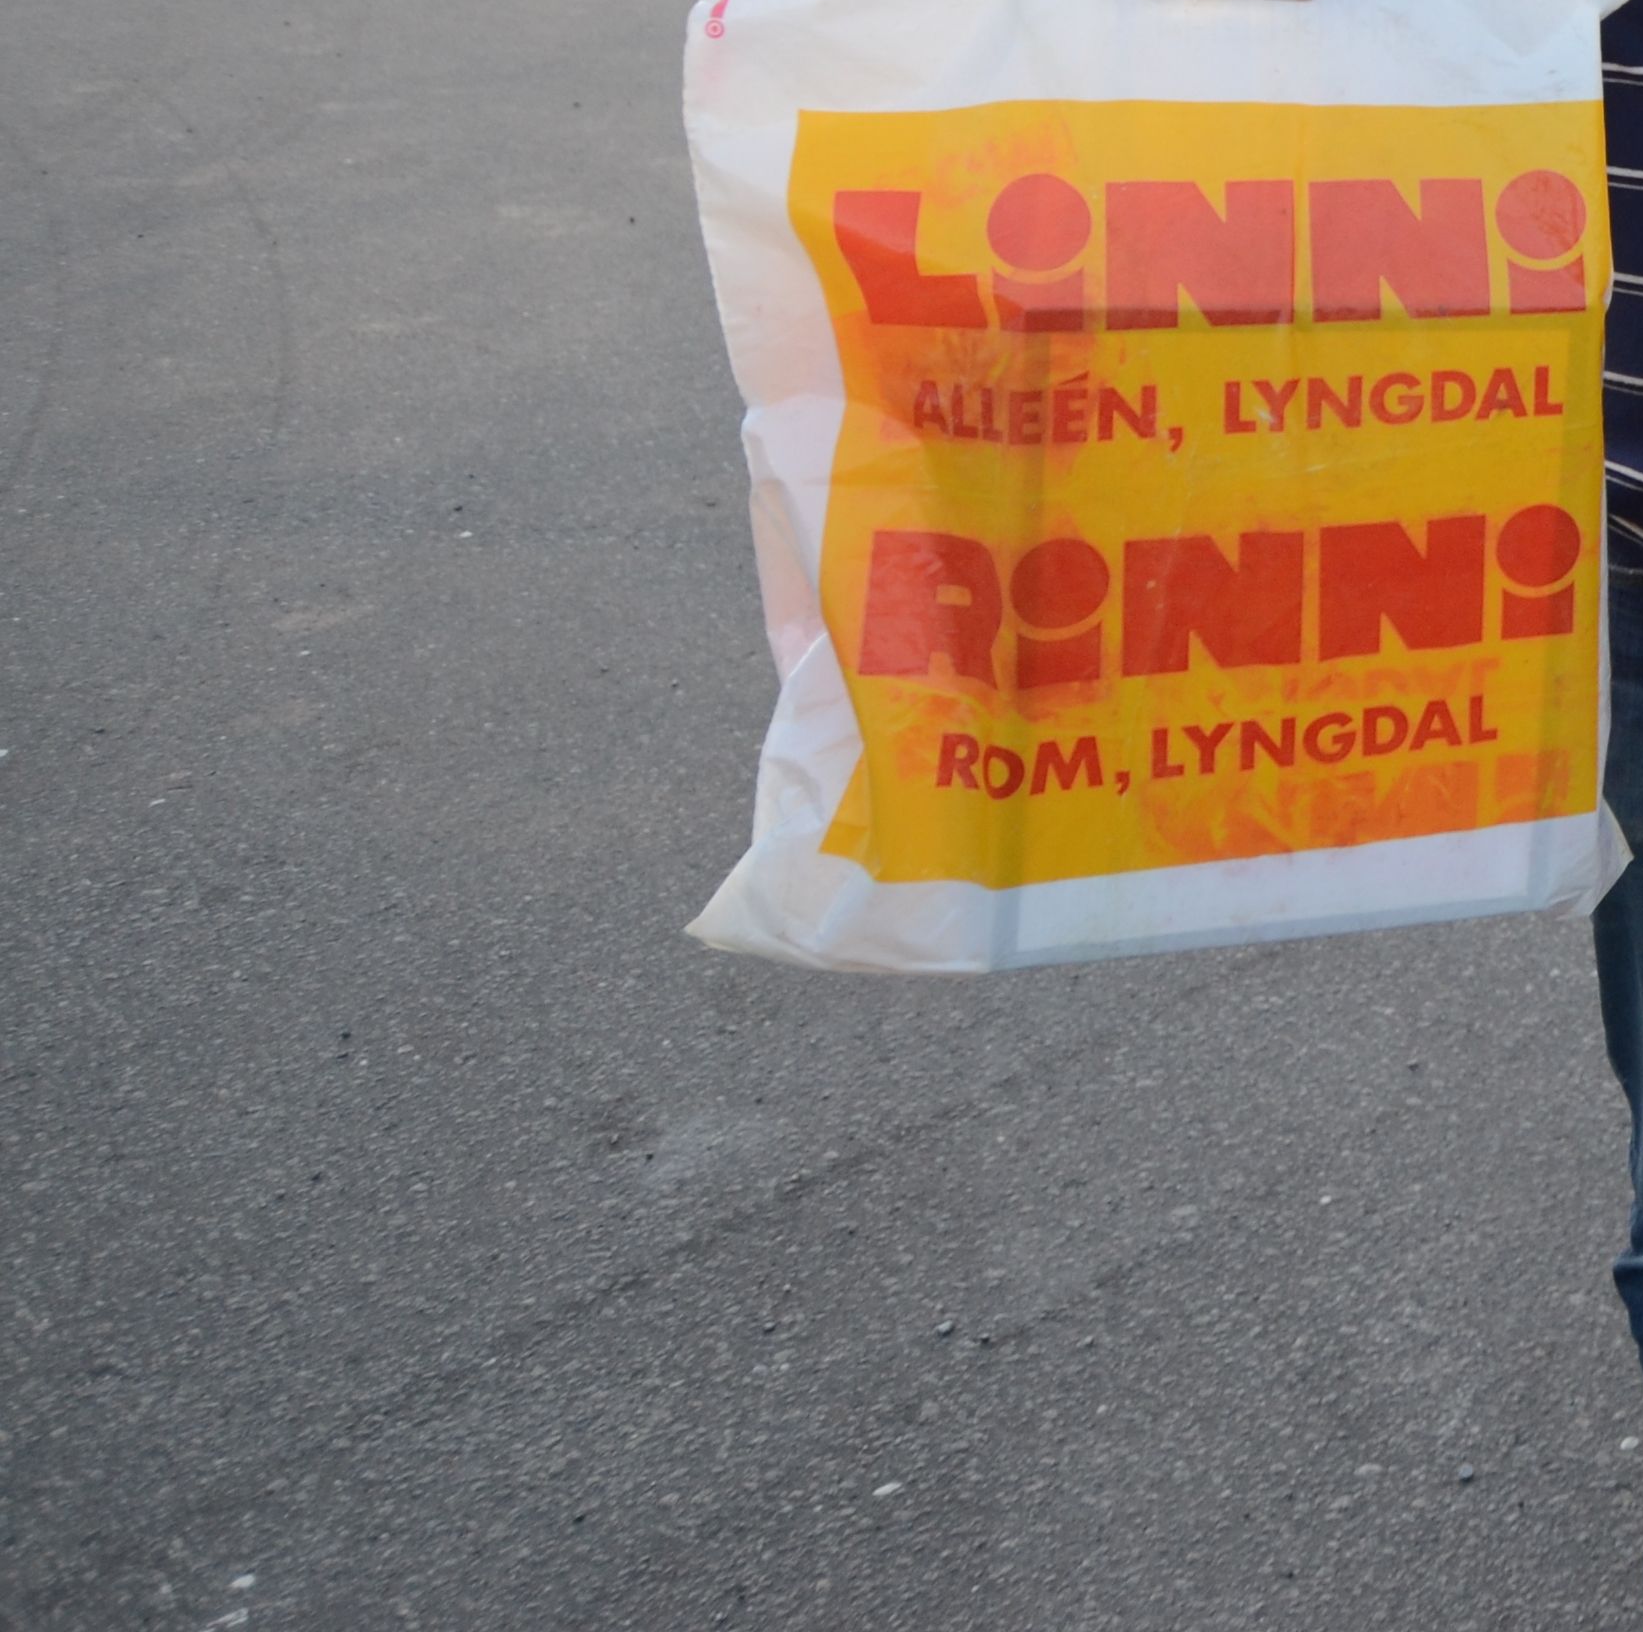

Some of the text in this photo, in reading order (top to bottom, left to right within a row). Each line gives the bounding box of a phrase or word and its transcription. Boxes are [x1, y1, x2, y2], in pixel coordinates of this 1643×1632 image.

[1222, 364, 1564, 435] LYNGDAL
[935, 694, 1499, 801] ROM, LYNGDAL
